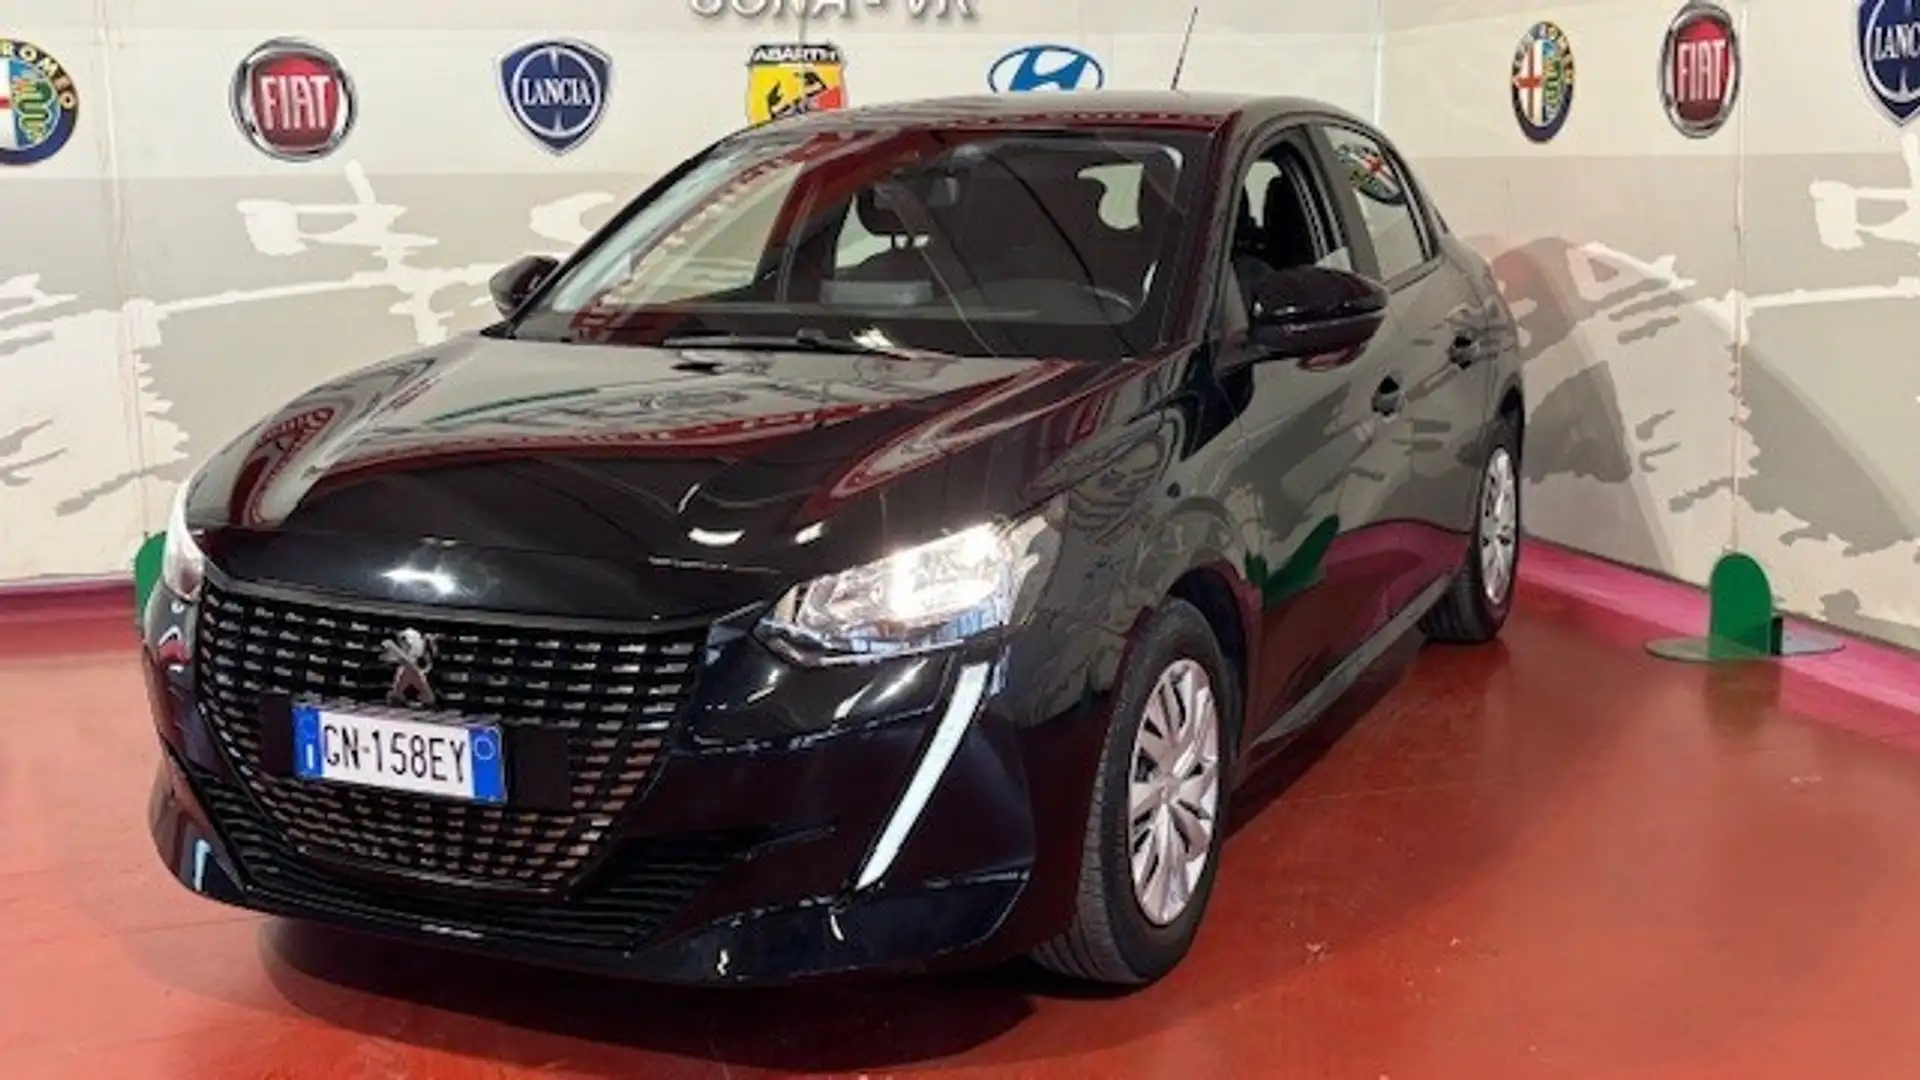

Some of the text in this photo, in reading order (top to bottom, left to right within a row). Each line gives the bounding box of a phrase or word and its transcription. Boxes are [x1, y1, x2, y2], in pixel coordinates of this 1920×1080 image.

[3, 42, 76, 109] ROMEO
[522, 77, 593, 106] LANCIA
[1677, 39, 1726, 102] FIAT
[260, 74, 331, 130] FIAT
